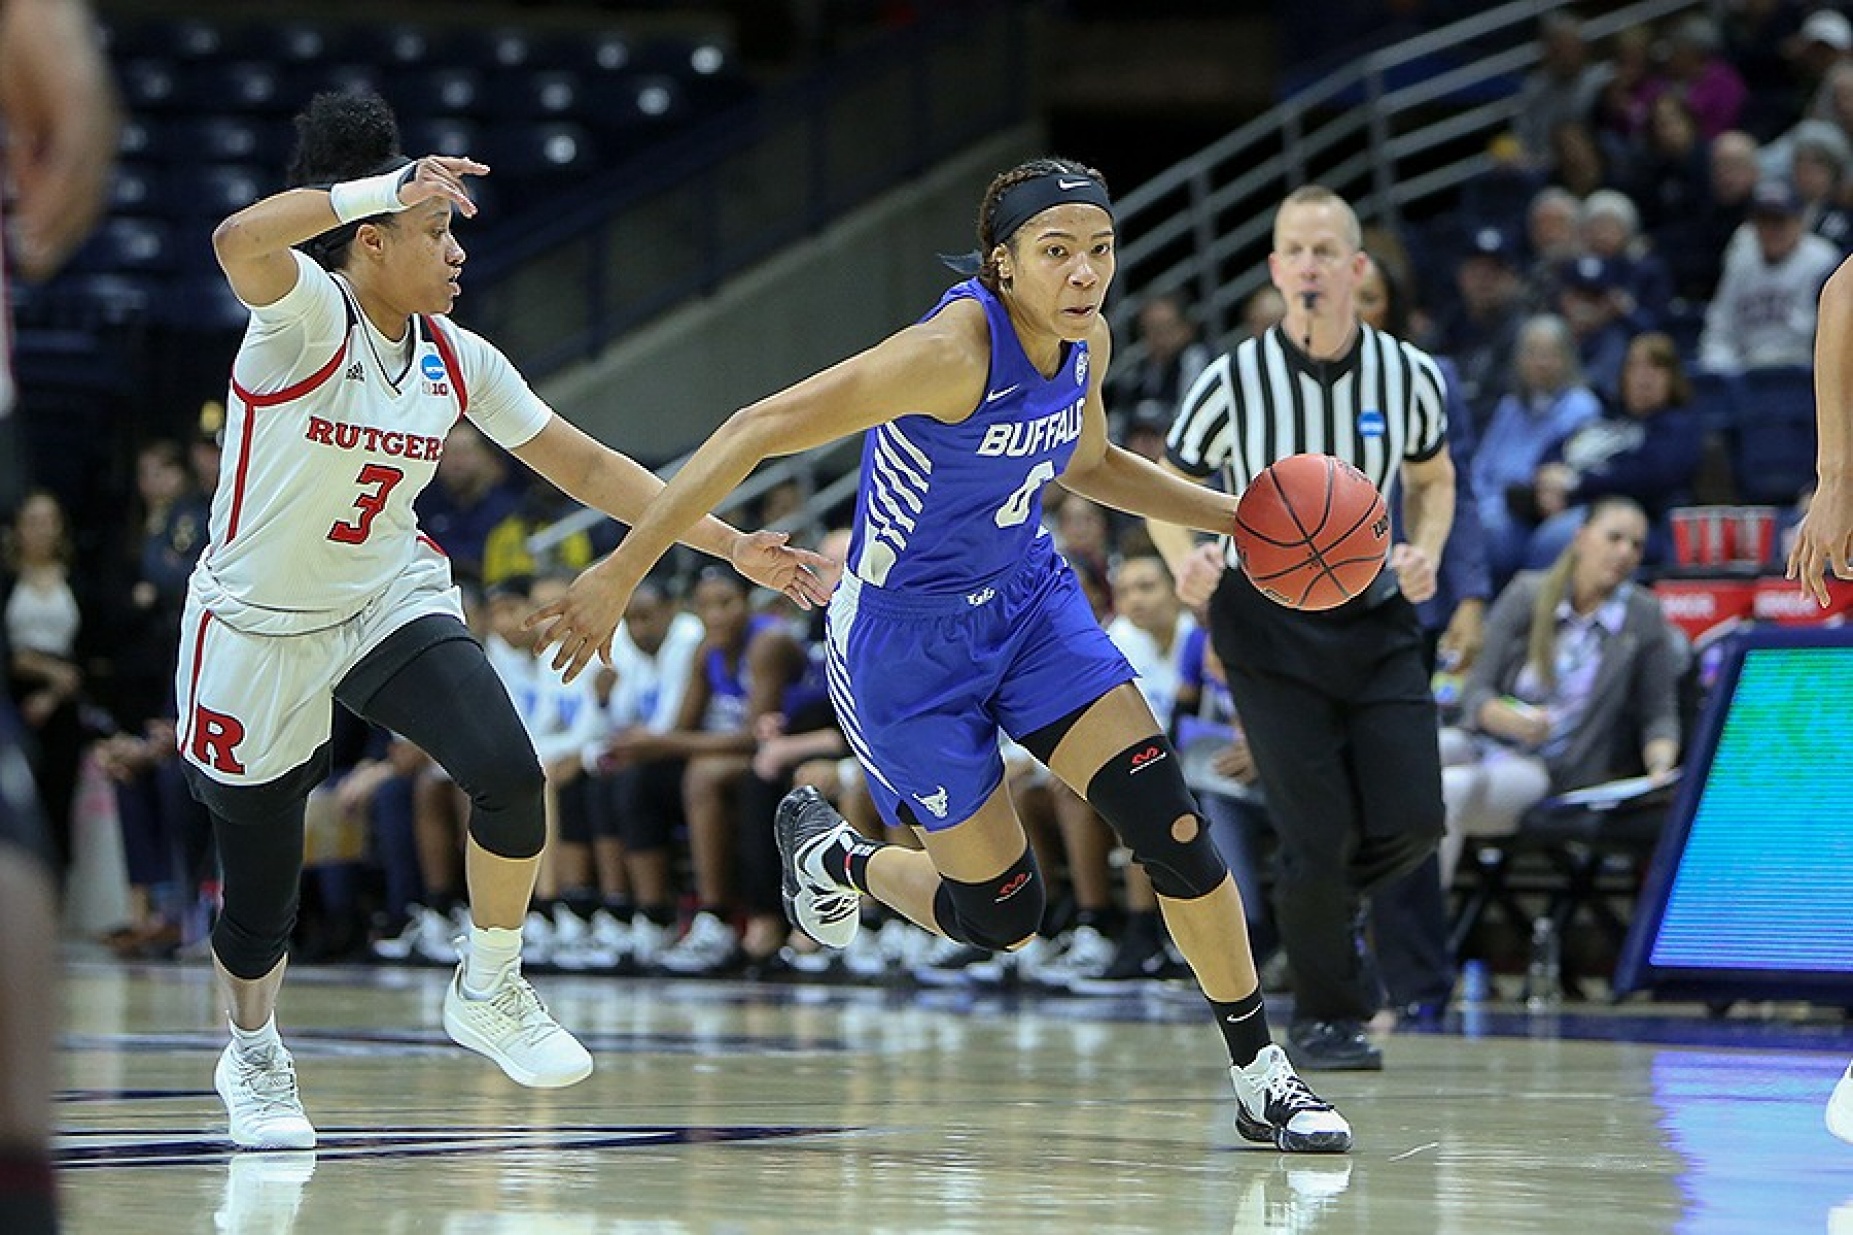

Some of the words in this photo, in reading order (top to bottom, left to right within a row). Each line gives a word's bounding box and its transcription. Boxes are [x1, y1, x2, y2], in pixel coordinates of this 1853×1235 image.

[306, 415, 444, 462] RUTGER
[326, 462, 405, 545] 3
[191, 702, 246, 776] R
